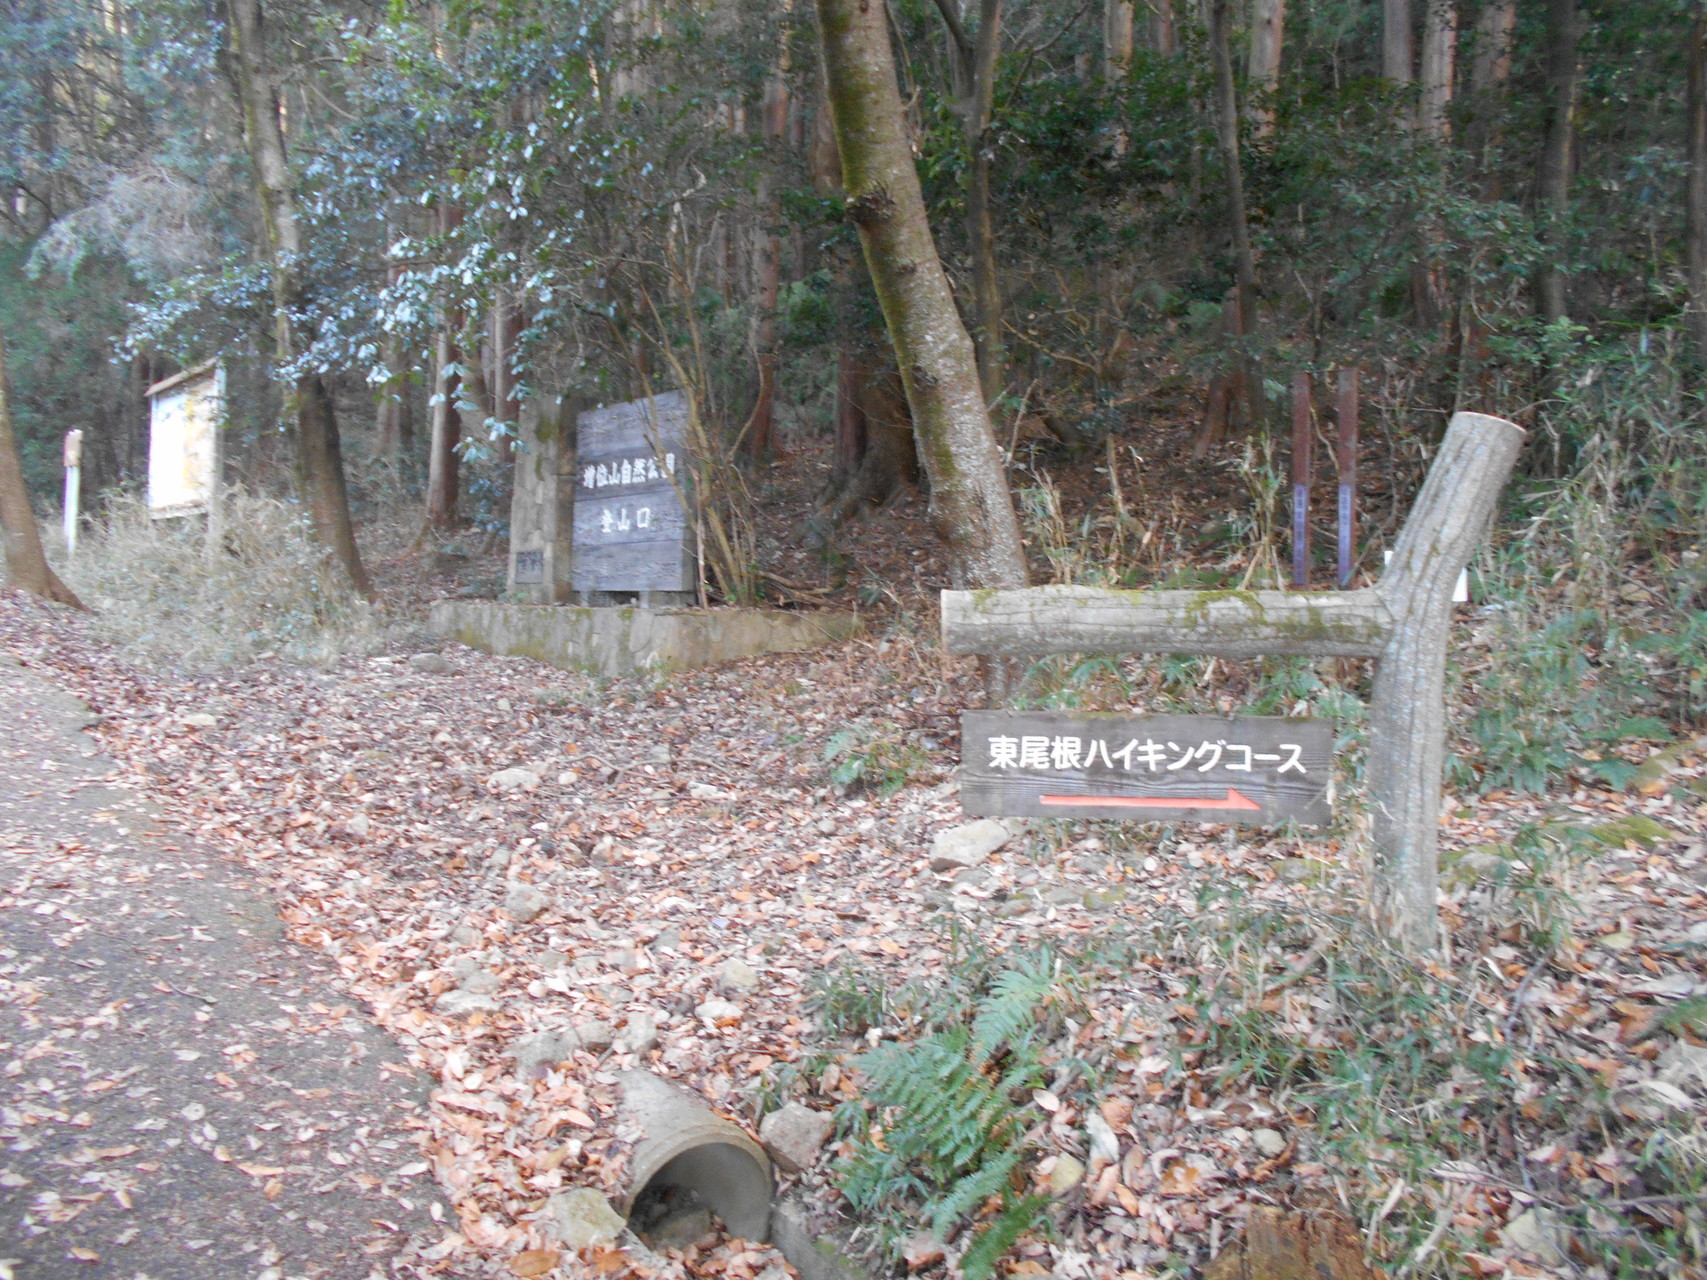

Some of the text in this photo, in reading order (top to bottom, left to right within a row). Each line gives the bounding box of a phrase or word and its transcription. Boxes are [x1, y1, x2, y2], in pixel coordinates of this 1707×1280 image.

[602, 507, 650, 533] 登山口
[988, 735, 1306, 774] 東尾根ハイキングコース
